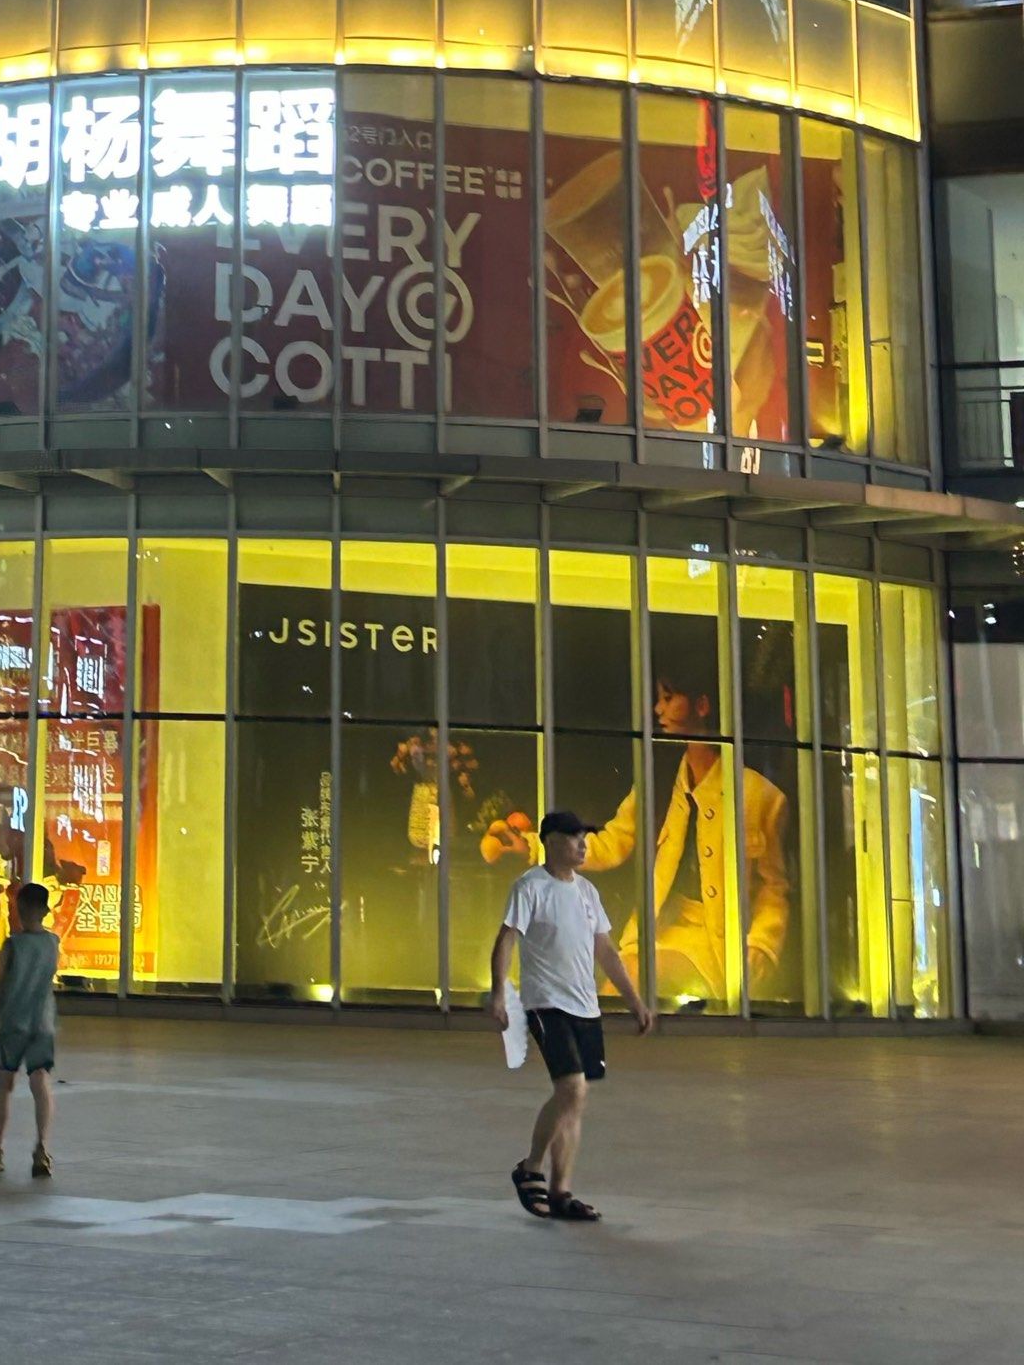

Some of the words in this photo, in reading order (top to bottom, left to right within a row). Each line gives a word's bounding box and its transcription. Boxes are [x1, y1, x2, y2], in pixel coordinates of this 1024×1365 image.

[341, 154, 486, 197] COFFEE
[216, 202, 481, 270] ERY
[216, 261, 387, 335] DAY
[209, 336, 453, 413] COTTI
